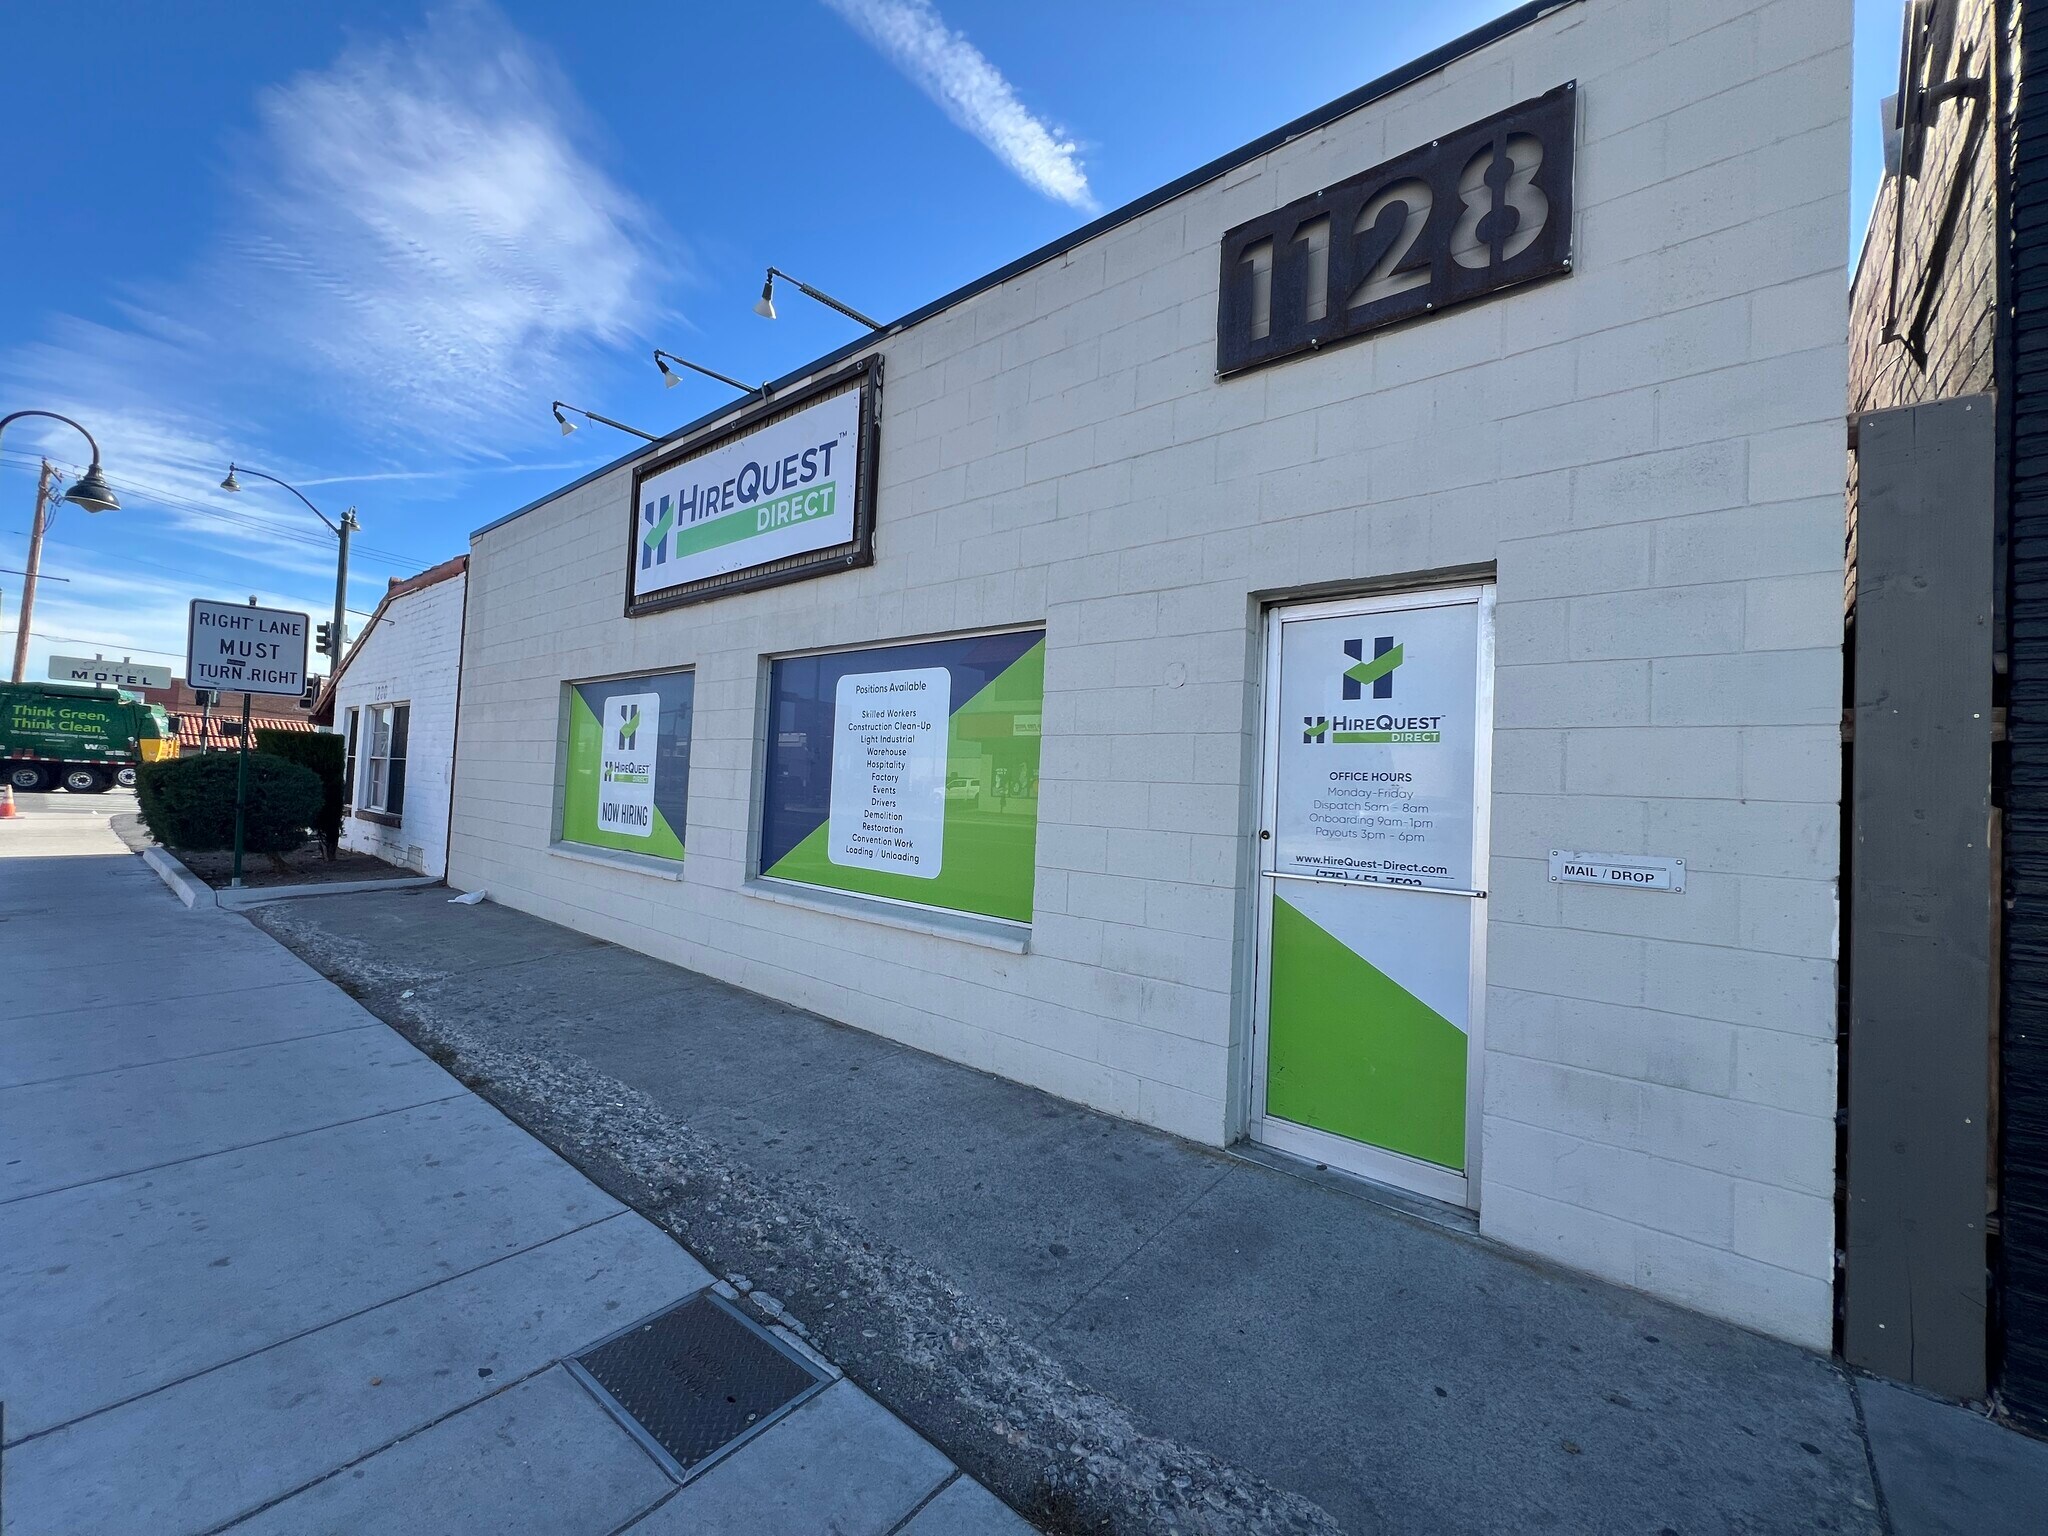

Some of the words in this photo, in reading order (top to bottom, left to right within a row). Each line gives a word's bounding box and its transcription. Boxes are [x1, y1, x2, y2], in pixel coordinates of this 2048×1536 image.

[1237, 131, 1549, 342] 1128
[756, 486, 834, 532] DIRECT
[199, 612, 252, 630] RIGHT
[259, 619, 301, 637] LANE
[219, 638, 280, 660] MUST
[71, 670, 152, 686] MOTEL
[198, 663, 242, 680] TURN
[251, 668, 298, 685] RIGHT
[856, 683, 888, 694] Positions
[889, 681, 927, 693] Available
[12, 704, 55, 717] Think
[59, 708, 111, 723] Green,
[862, 710, 885, 719] Skilled
[886, 709, 917, 718] Workers
[11, 717, 55, 730] Think
[58, 721, 106, 733] Clean.
[848, 722, 892, 731] Construction
[894, 721, 932, 732] Clean-Up
[860, 735, 878, 746] Light
[880, 735, 915, 744] Industrial
[1391, 732, 1439, 742] DIRECT
[866, 747, 907, 757] Warehouse
[866, 760, 906, 770] Hospitality
[871, 772, 899, 783] Factory
[1329, 771, 1369, 781] OFFICE
[1371, 772, 1412, 783] HOURS
[872, 785, 896, 795] Events
[1327, 786, 1414, 801] Monday-Friday
[871, 797, 896, 808] Drivers
[1313, 799, 1361, 811] Dispatch
[1364, 801, 1389, 812] 5am
[1402, 803, 1429, 813] 8am
[602, 802, 620, 823] NOW
[620, 803, 648, 827] HIRING
[864, 809, 903, 821] Demolition
[1309, 812, 1375, 827] Onboarding
[1377, 816, 1433, 829] 9am-1pm
[862, 822, 904, 834] Restoration
[1315, 826, 1358, 838] Payouts
[1361, 829, 1386, 840] 3pm
[1398, 831, 1425, 843] 6pm
[852, 833, 892, 847] Convention
[894, 838, 914, 849] Work
[845, 845, 874, 858] Loading
[881, 850, 920, 865] Unloading
[1296, 854, 1448, 875] www.HireQuest-Direct.com
[1564, 865, 1598, 878] MAIL
[1602, 868, 1607, 879] /
[1611, 870, 1655, 883] DROP
